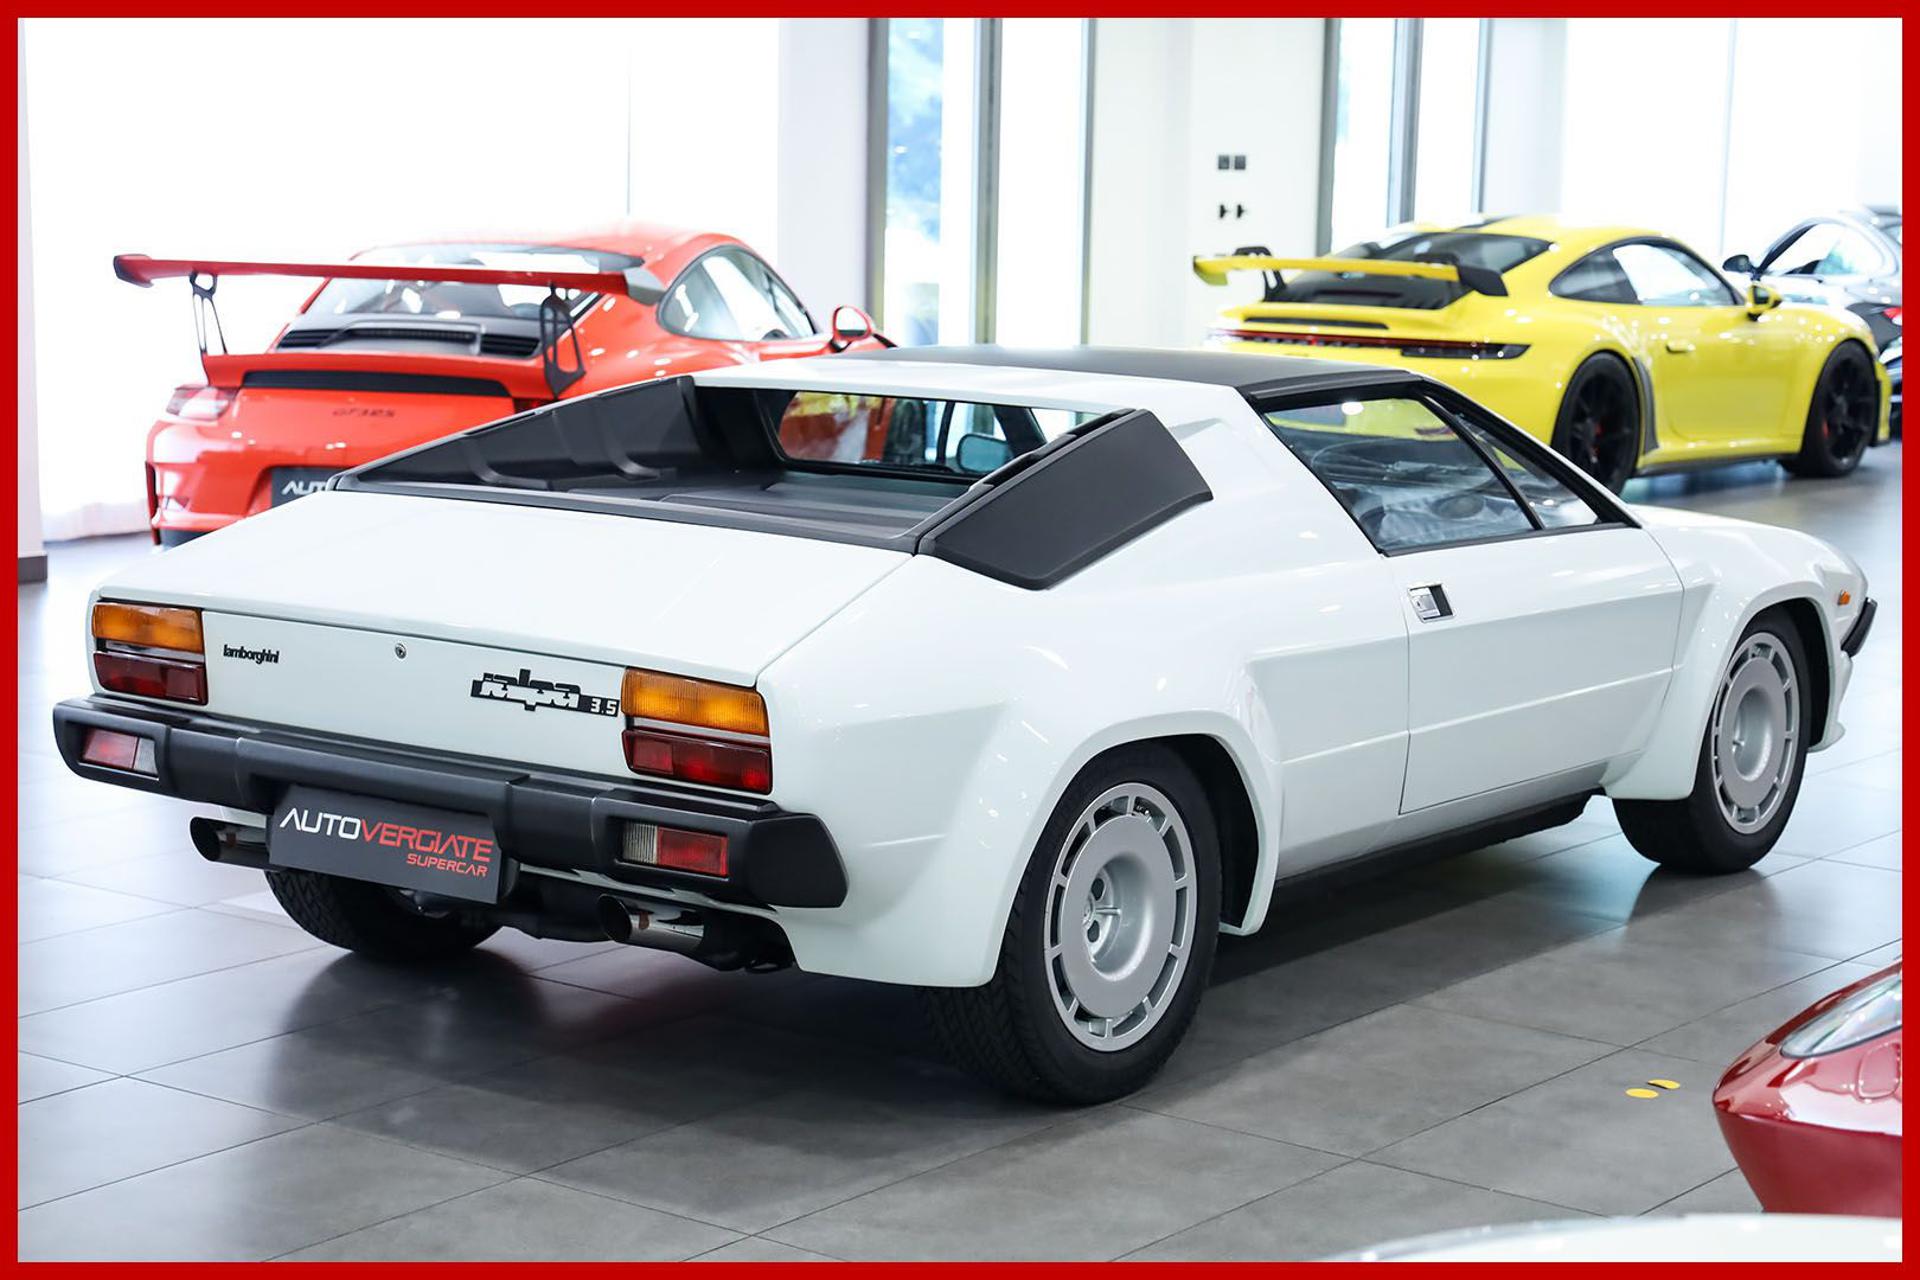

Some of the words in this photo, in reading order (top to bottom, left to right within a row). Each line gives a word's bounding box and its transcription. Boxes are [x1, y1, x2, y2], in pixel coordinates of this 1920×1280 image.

[590, 697, 618, 716] 3.5
[279, 807, 494, 863] AUTOVERGIATE
[406, 852, 488, 878] SUPERCAR
